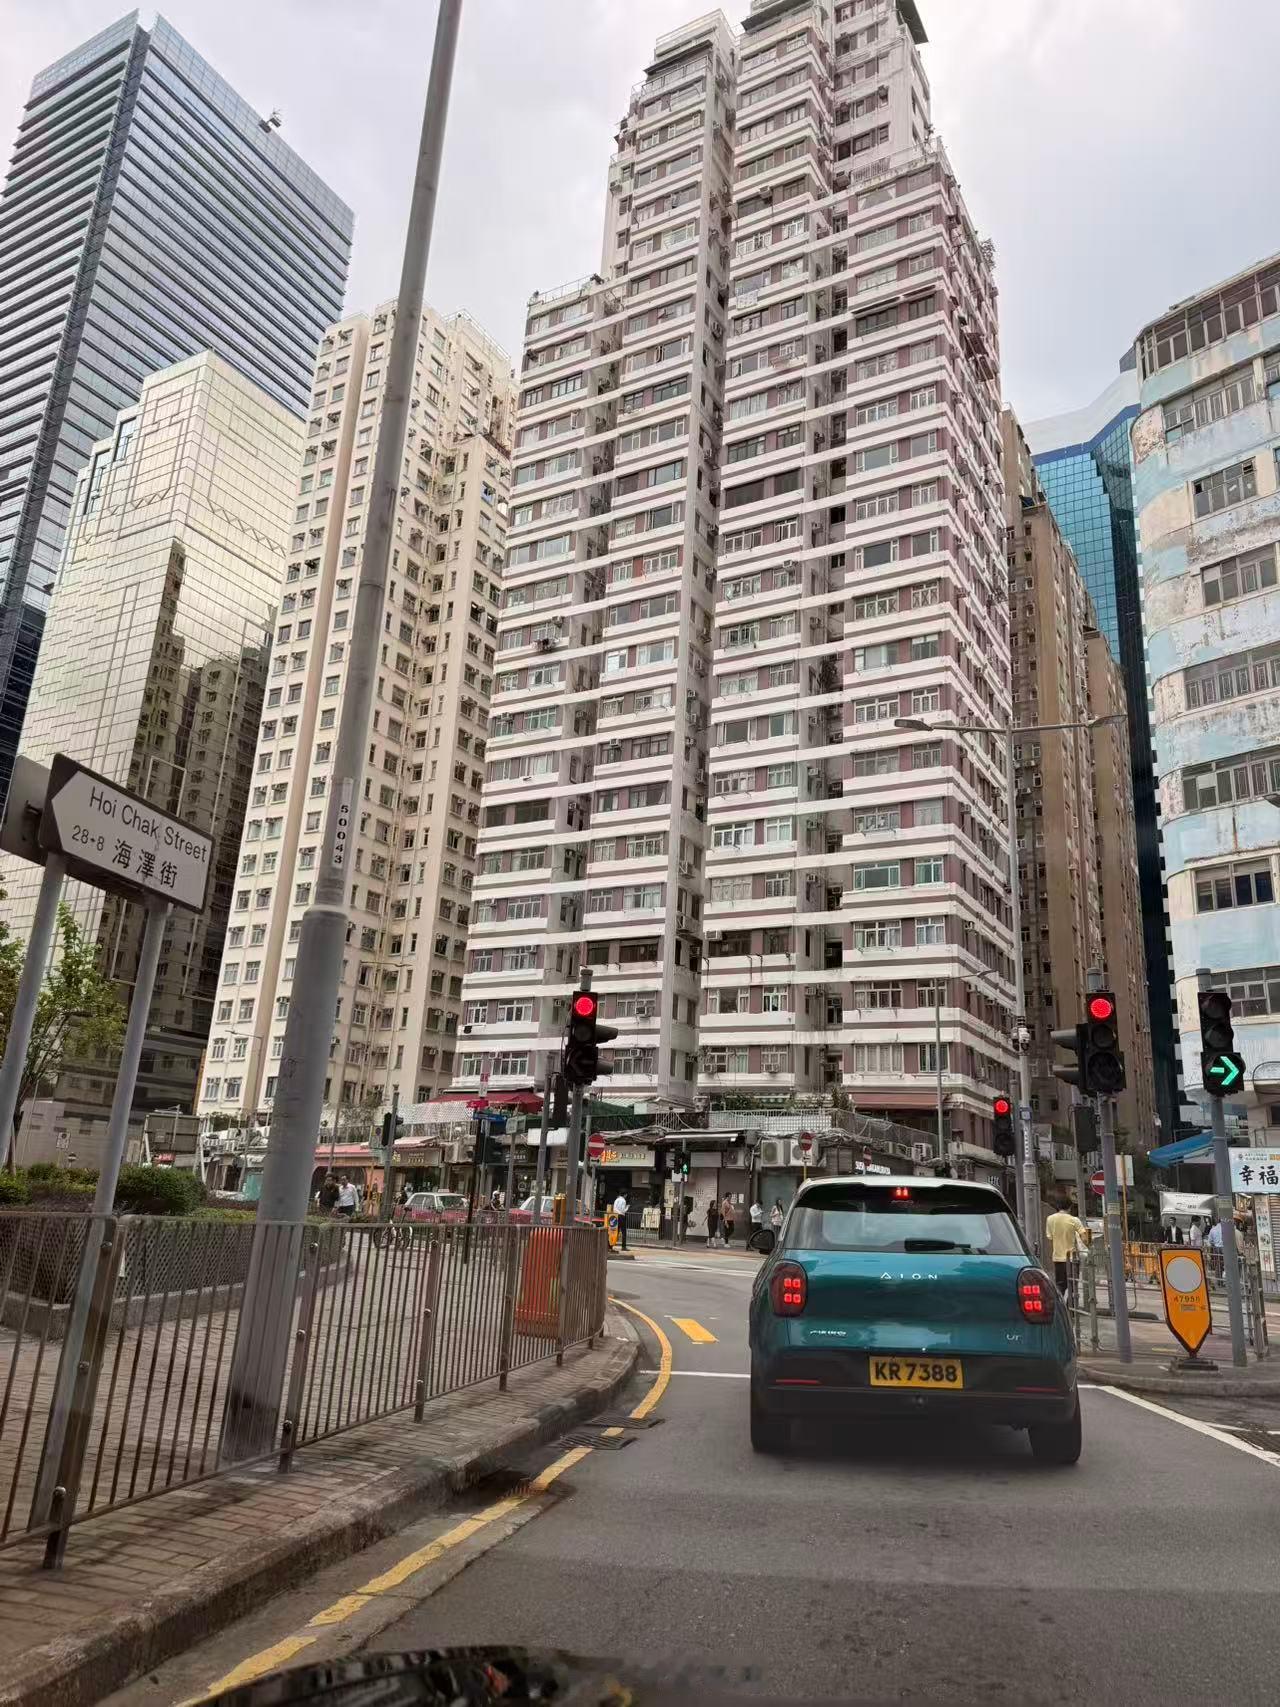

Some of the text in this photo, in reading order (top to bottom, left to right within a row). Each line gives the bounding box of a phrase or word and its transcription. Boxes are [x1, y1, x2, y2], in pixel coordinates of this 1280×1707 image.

[89, 786, 207, 863] Hoi Chak Street
[334, 804, 349, 864] 50043
[112, 838, 178, 889] 海澤街
[880, 1271, 938, 1281] AION
